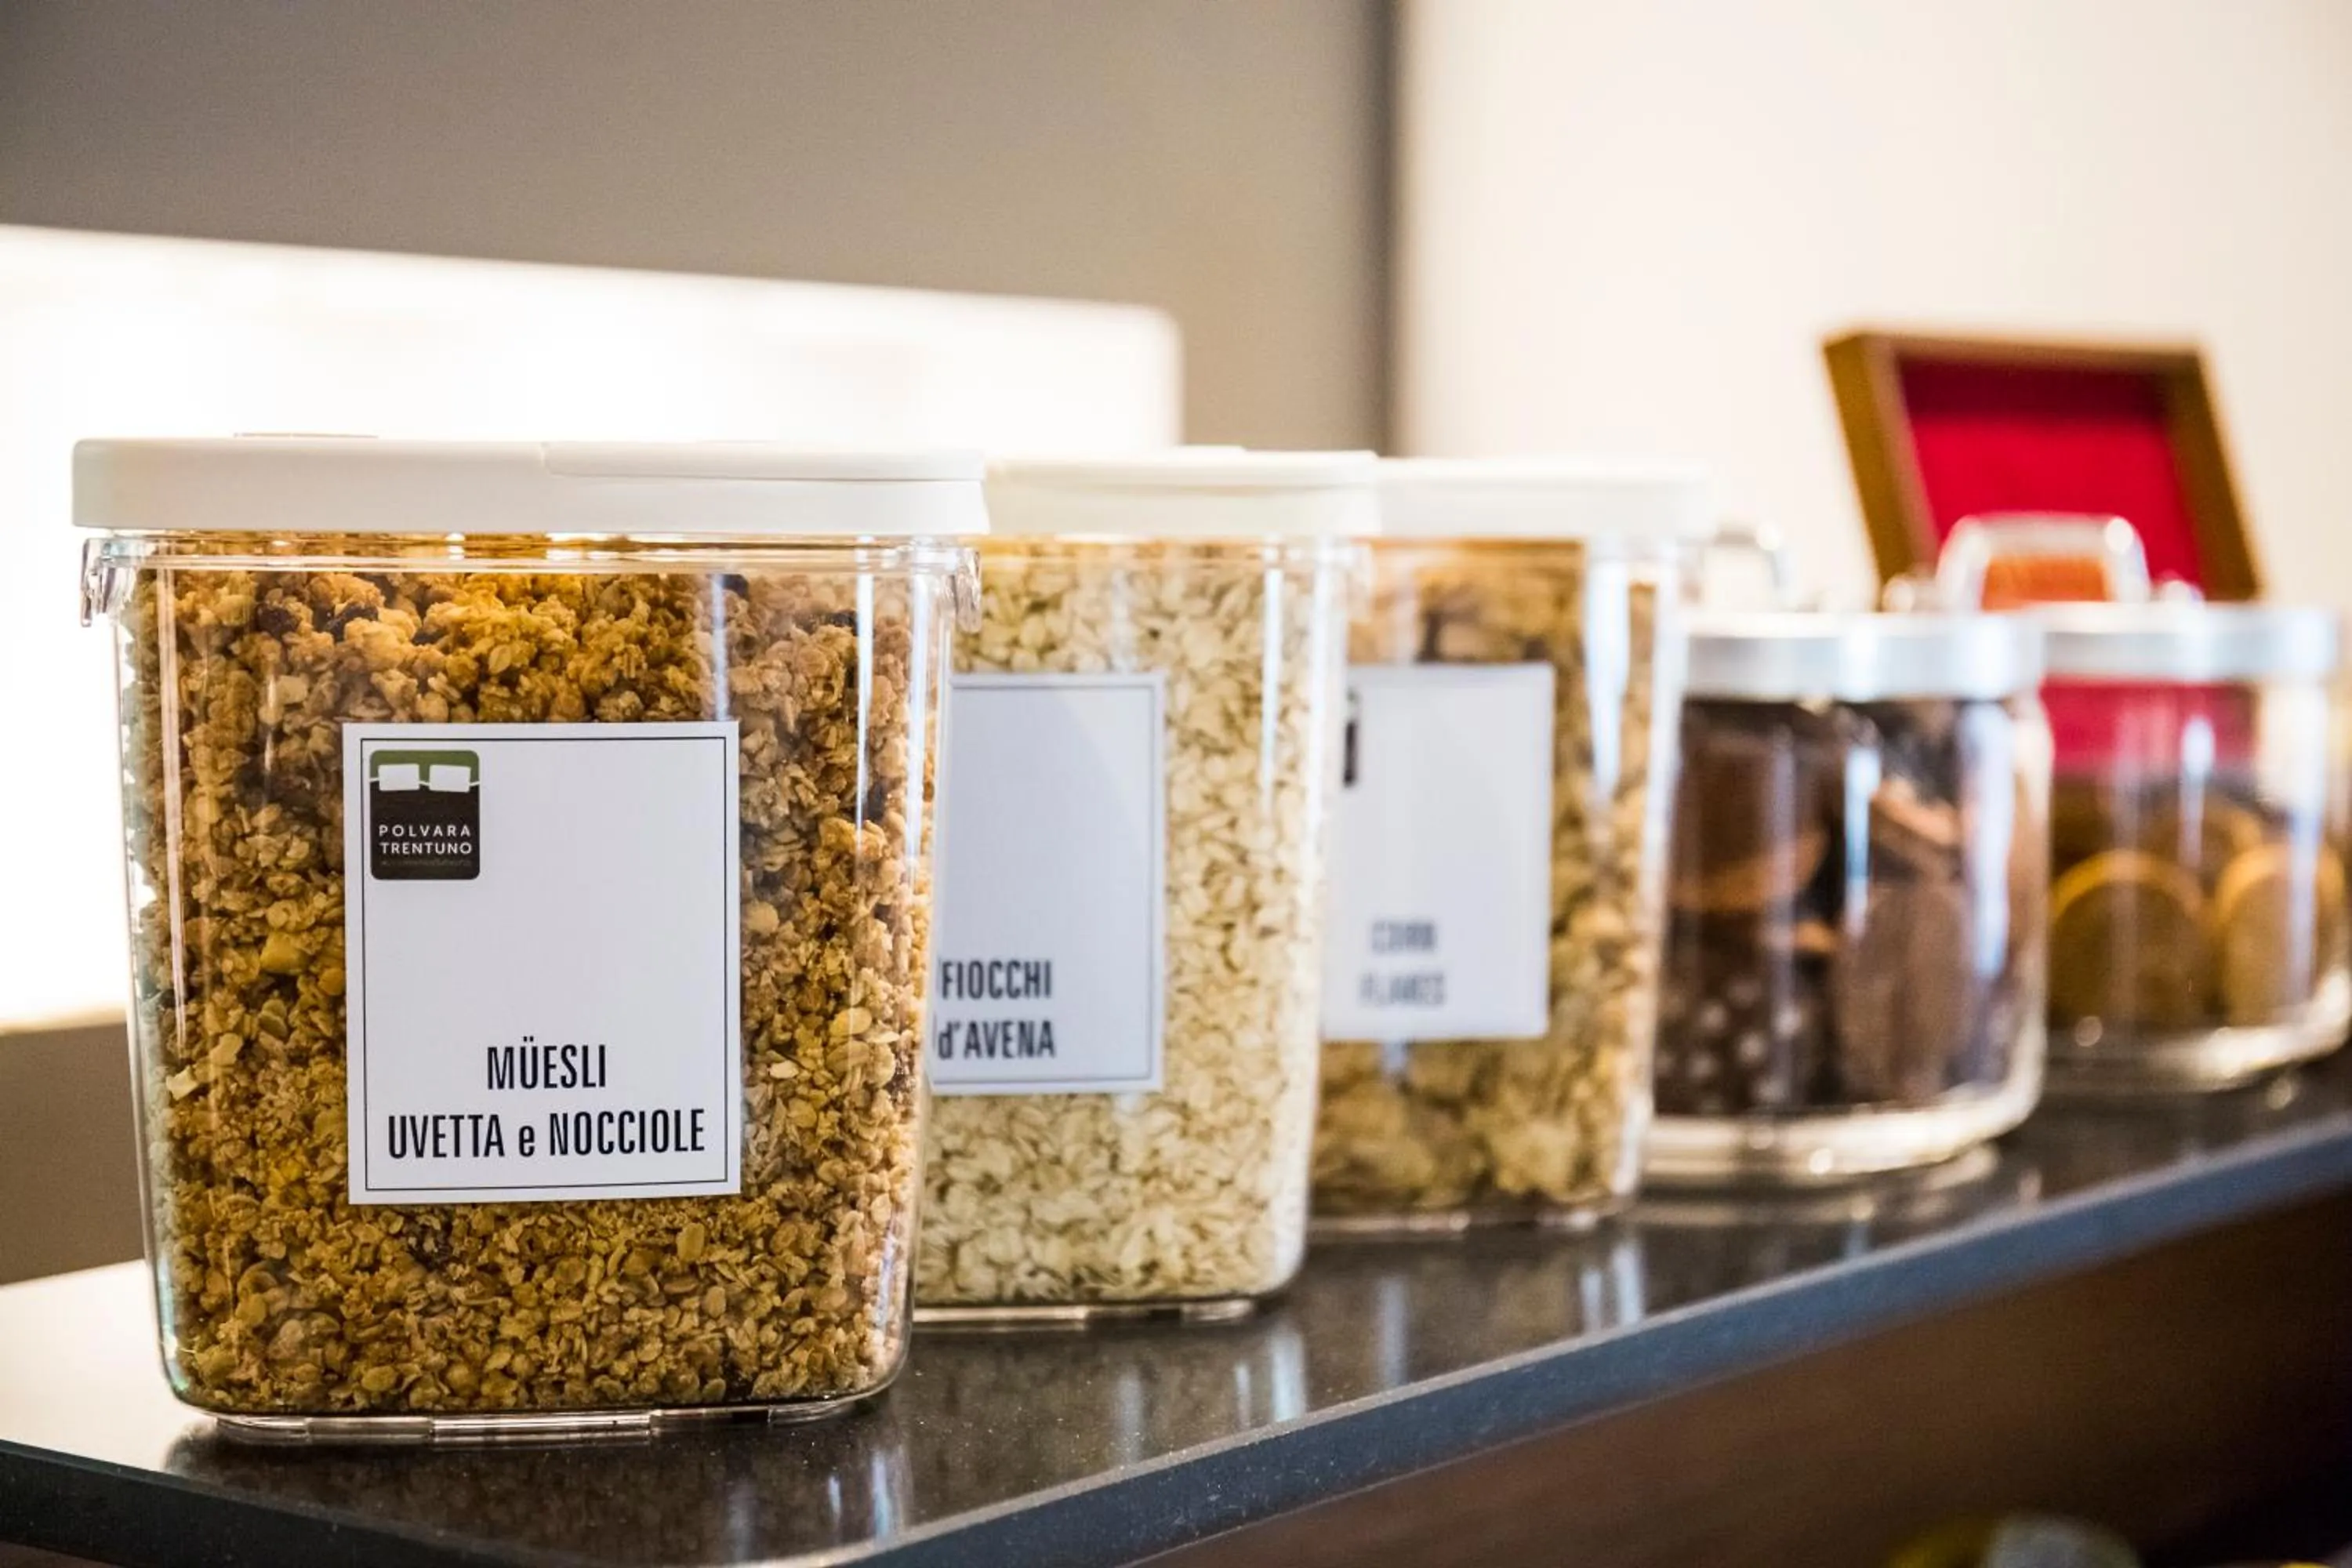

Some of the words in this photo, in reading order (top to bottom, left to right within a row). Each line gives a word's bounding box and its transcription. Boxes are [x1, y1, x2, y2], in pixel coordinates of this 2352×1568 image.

[379, 824, 471, 837] POLVARA
[379, 842, 473, 855] TRENTUNO
[941, 959, 1052, 1000] FIOCCHI
[938, 1020, 1055, 1060] d'AVENA
[487, 1036, 607, 1090] MÜESLI
[388, 1114, 505, 1160] UVETTA
[518, 1123, 535, 1158] e
[549, 1108, 706, 1156] NOCCIOLE
